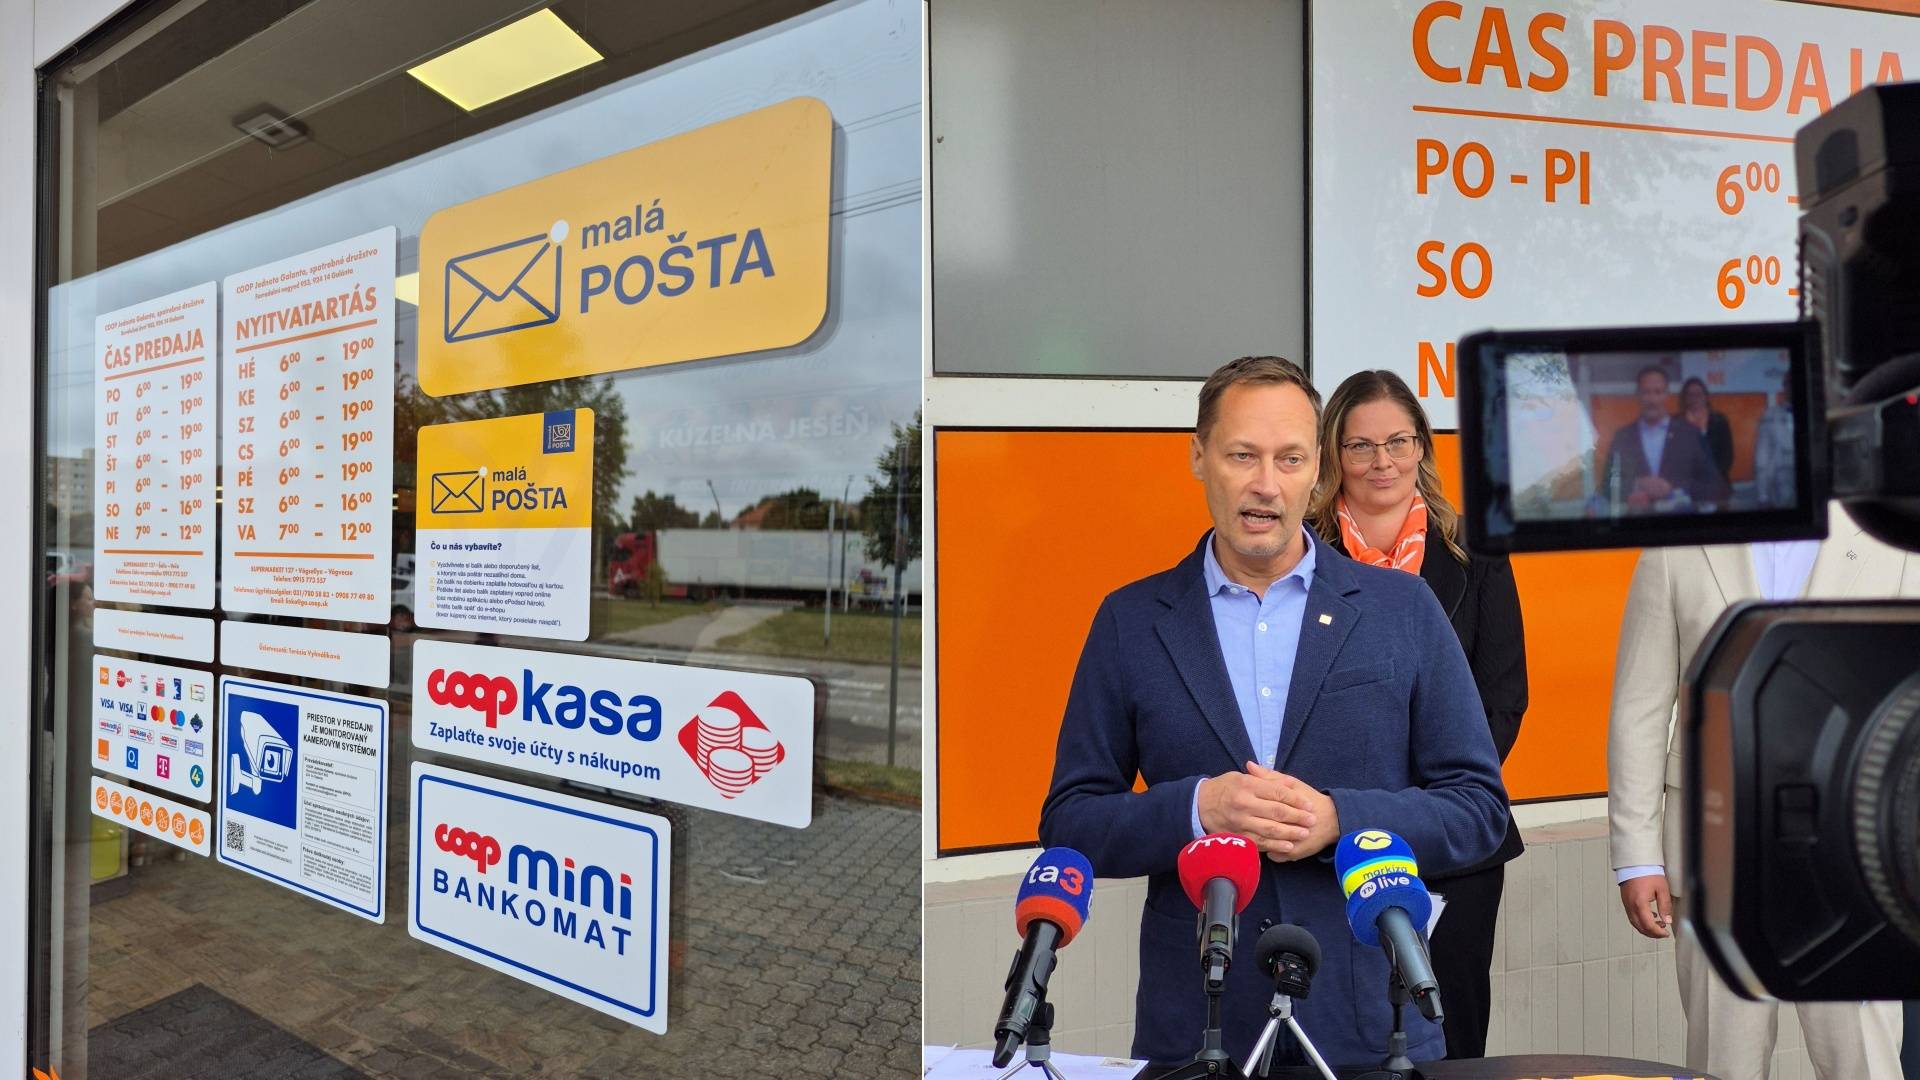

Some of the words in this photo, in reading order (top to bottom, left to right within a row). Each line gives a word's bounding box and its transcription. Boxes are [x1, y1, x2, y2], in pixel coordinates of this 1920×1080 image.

[1416, 139, 1495, 199] PO
[1510, 174, 1528, 184] -
[1545, 148, 1590, 205] PI
[581, 198, 665, 250] malá
[345, 247, 378, 263] družstvo
[579, 228, 776, 314] POŠTA
[1416, 240, 1493, 299] SO
[236, 283, 377, 341] NYITVATARTÁS
[104, 344, 131, 370] ČAS
[135, 328, 204, 363] PREDAJA
[238, 357, 255, 379] HÉ
[1418, 342, 1456, 398] N
[106, 388, 120, 403] PO
[238, 389, 255, 406] KE
[106, 411, 119, 426] UT
[238, 416, 255, 433] SZ
[106, 434, 117, 449] ST
[551, 441, 570, 449] POŠTA
[238, 443, 254, 460] CS
[106, 454, 117, 471] ŠT
[238, 466, 253, 486] PÉ
[492, 466, 527, 482] malá
[106, 480, 115, 494] PI
[238, 497, 254, 513] SZ
[491, 482, 568, 511] POŠTA
[106, 503, 120, 517] SO
[105, 526, 119, 540] NE
[237, 525, 256, 541] VA
[430, 540, 441, 550] Čo
[448, 542, 463, 550] nás
[464, 542, 502, 552] vybavíte?
[498, 562, 530, 571] doporučený
[484, 606, 506, 614] e-shopu
[100, 697, 115, 709] VISA
[118, 701, 134, 714] VISA
[427, 668, 518, 729] coop
[522, 668, 662, 743] kasa
[306, 712, 336, 725] PRIESTOR
[336, 718, 342, 726] V
[342, 719, 374, 733] PREDAJNI
[310, 725, 318, 733] JE
[319, 726, 368, 743] MONITOROVANÝ
[303, 734, 341, 749] KAMEROVÝM
[341, 742, 377, 757] SYSTÉMOM
[430, 722, 485, 747] Zaplaťte
[488, 732, 526, 756] svoje
[530, 740, 564, 765] účty
[567, 750, 575, 764] s
[579, 750, 661, 781] nákupom
[434, 823, 502, 875] coop
[508, 844, 632, 921] mini
[1028, 865, 1084, 896] ta3
[1361, 884, 1374, 895] TN
[1377, 876, 1410, 889] live
[433, 868, 632, 956] BANKOMAT
